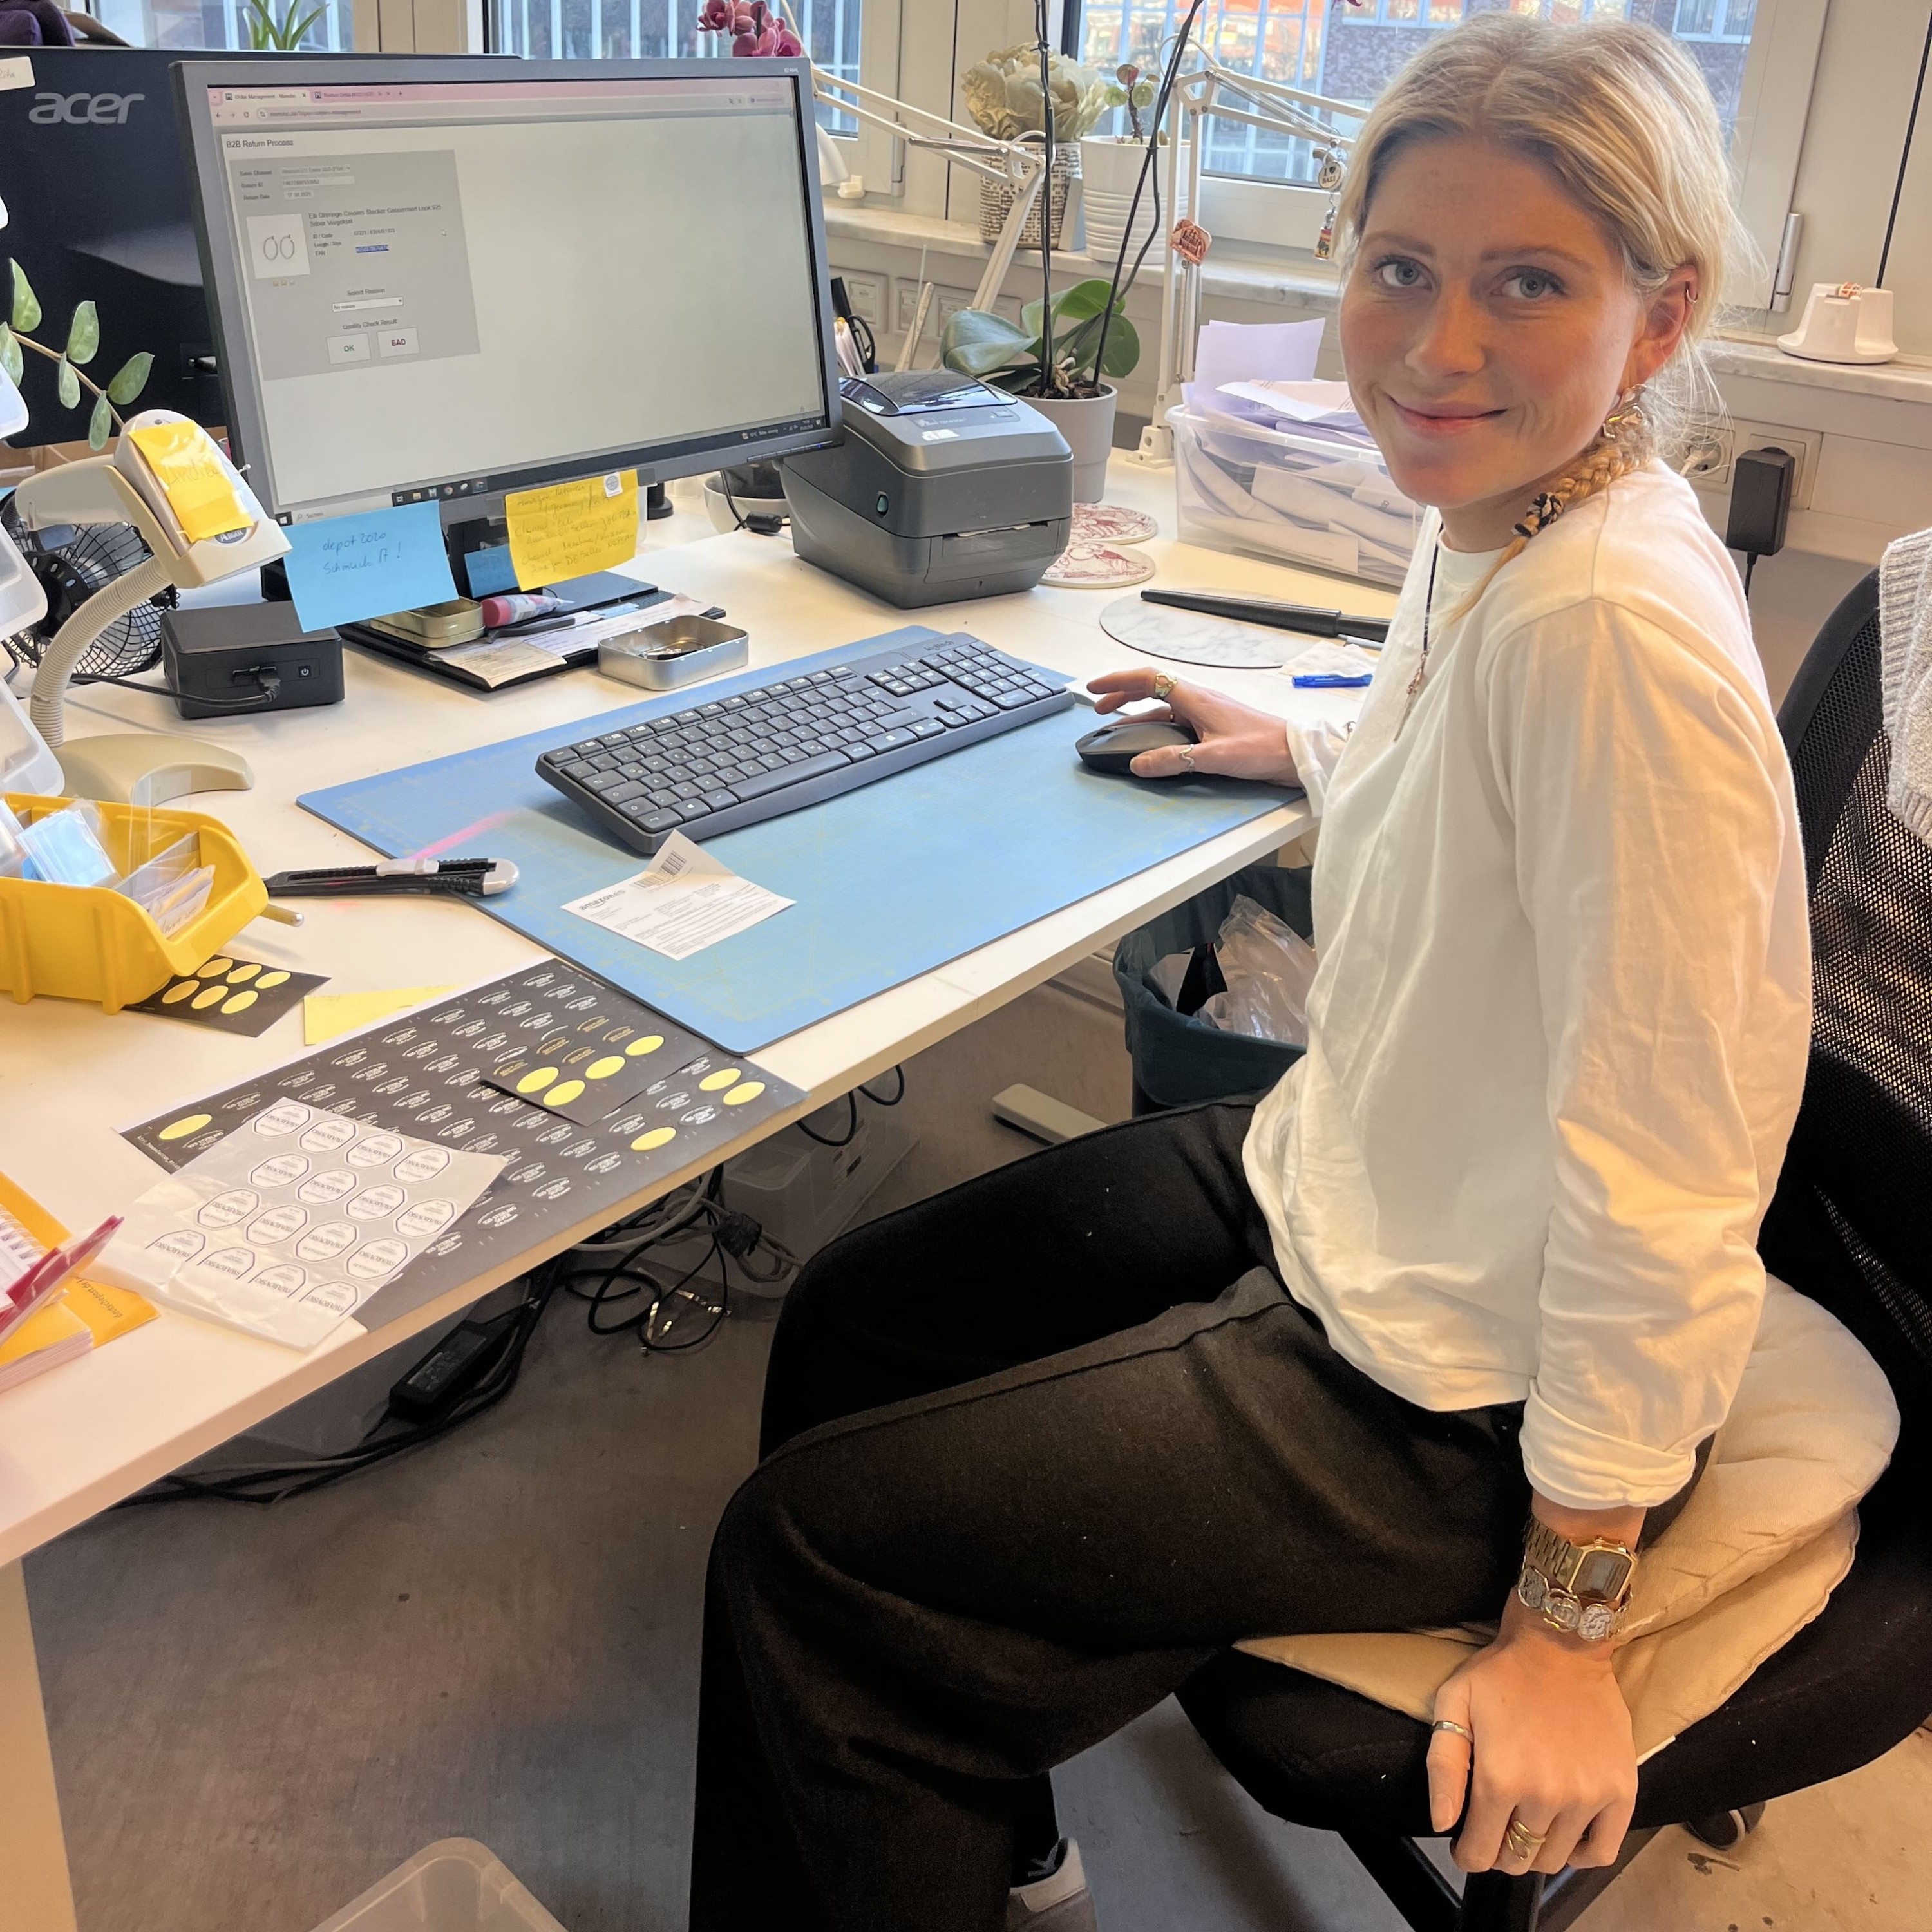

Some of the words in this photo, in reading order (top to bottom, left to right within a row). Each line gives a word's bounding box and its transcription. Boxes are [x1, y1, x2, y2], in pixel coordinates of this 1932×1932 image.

[28, 92, 146, 124] acer
[243, 139, 265, 147] Return
[1323, 167, 1327, 176] I
[1322, 175, 1336, 184] BALI
[391, 338, 406, 346] BAD
[323, 536, 357, 556] depot
[360, 531, 386, 544] 2020
[923, 640, 954, 651] logitech
[266, 1113, 299, 1128] SWAROVSKI
[311, 1128, 345, 1143] SWAROVSKI
[357, 1144, 392, 1158] SWAROVSKI
[263, 1164, 298, 1179] SWAROVSKI
[404, 1159, 440, 1172] SWAROVSKI
[309, 1179, 345, 1194] SWAROVSKI
[211, 1201, 246, 1217] SWAROVSKI
[358, 1195, 394, 1209] SWAROVSKI
[258, 1218, 296, 1233] SWAROVSKI
[406, 1211, 444, 1226] SWAROVSKI
[308, 1234, 345, 1249] SWAROVSKI
[155, 1242, 191, 1258] SWAROVSKI
[359, 1250, 396, 1266] SWAROVSKI
[205, 1260, 242, 1276] SWAROVSKI
[254, 1278, 294, 1294] SWAROVSKI
[306, 1295, 346, 1312] SWAROVSKI
